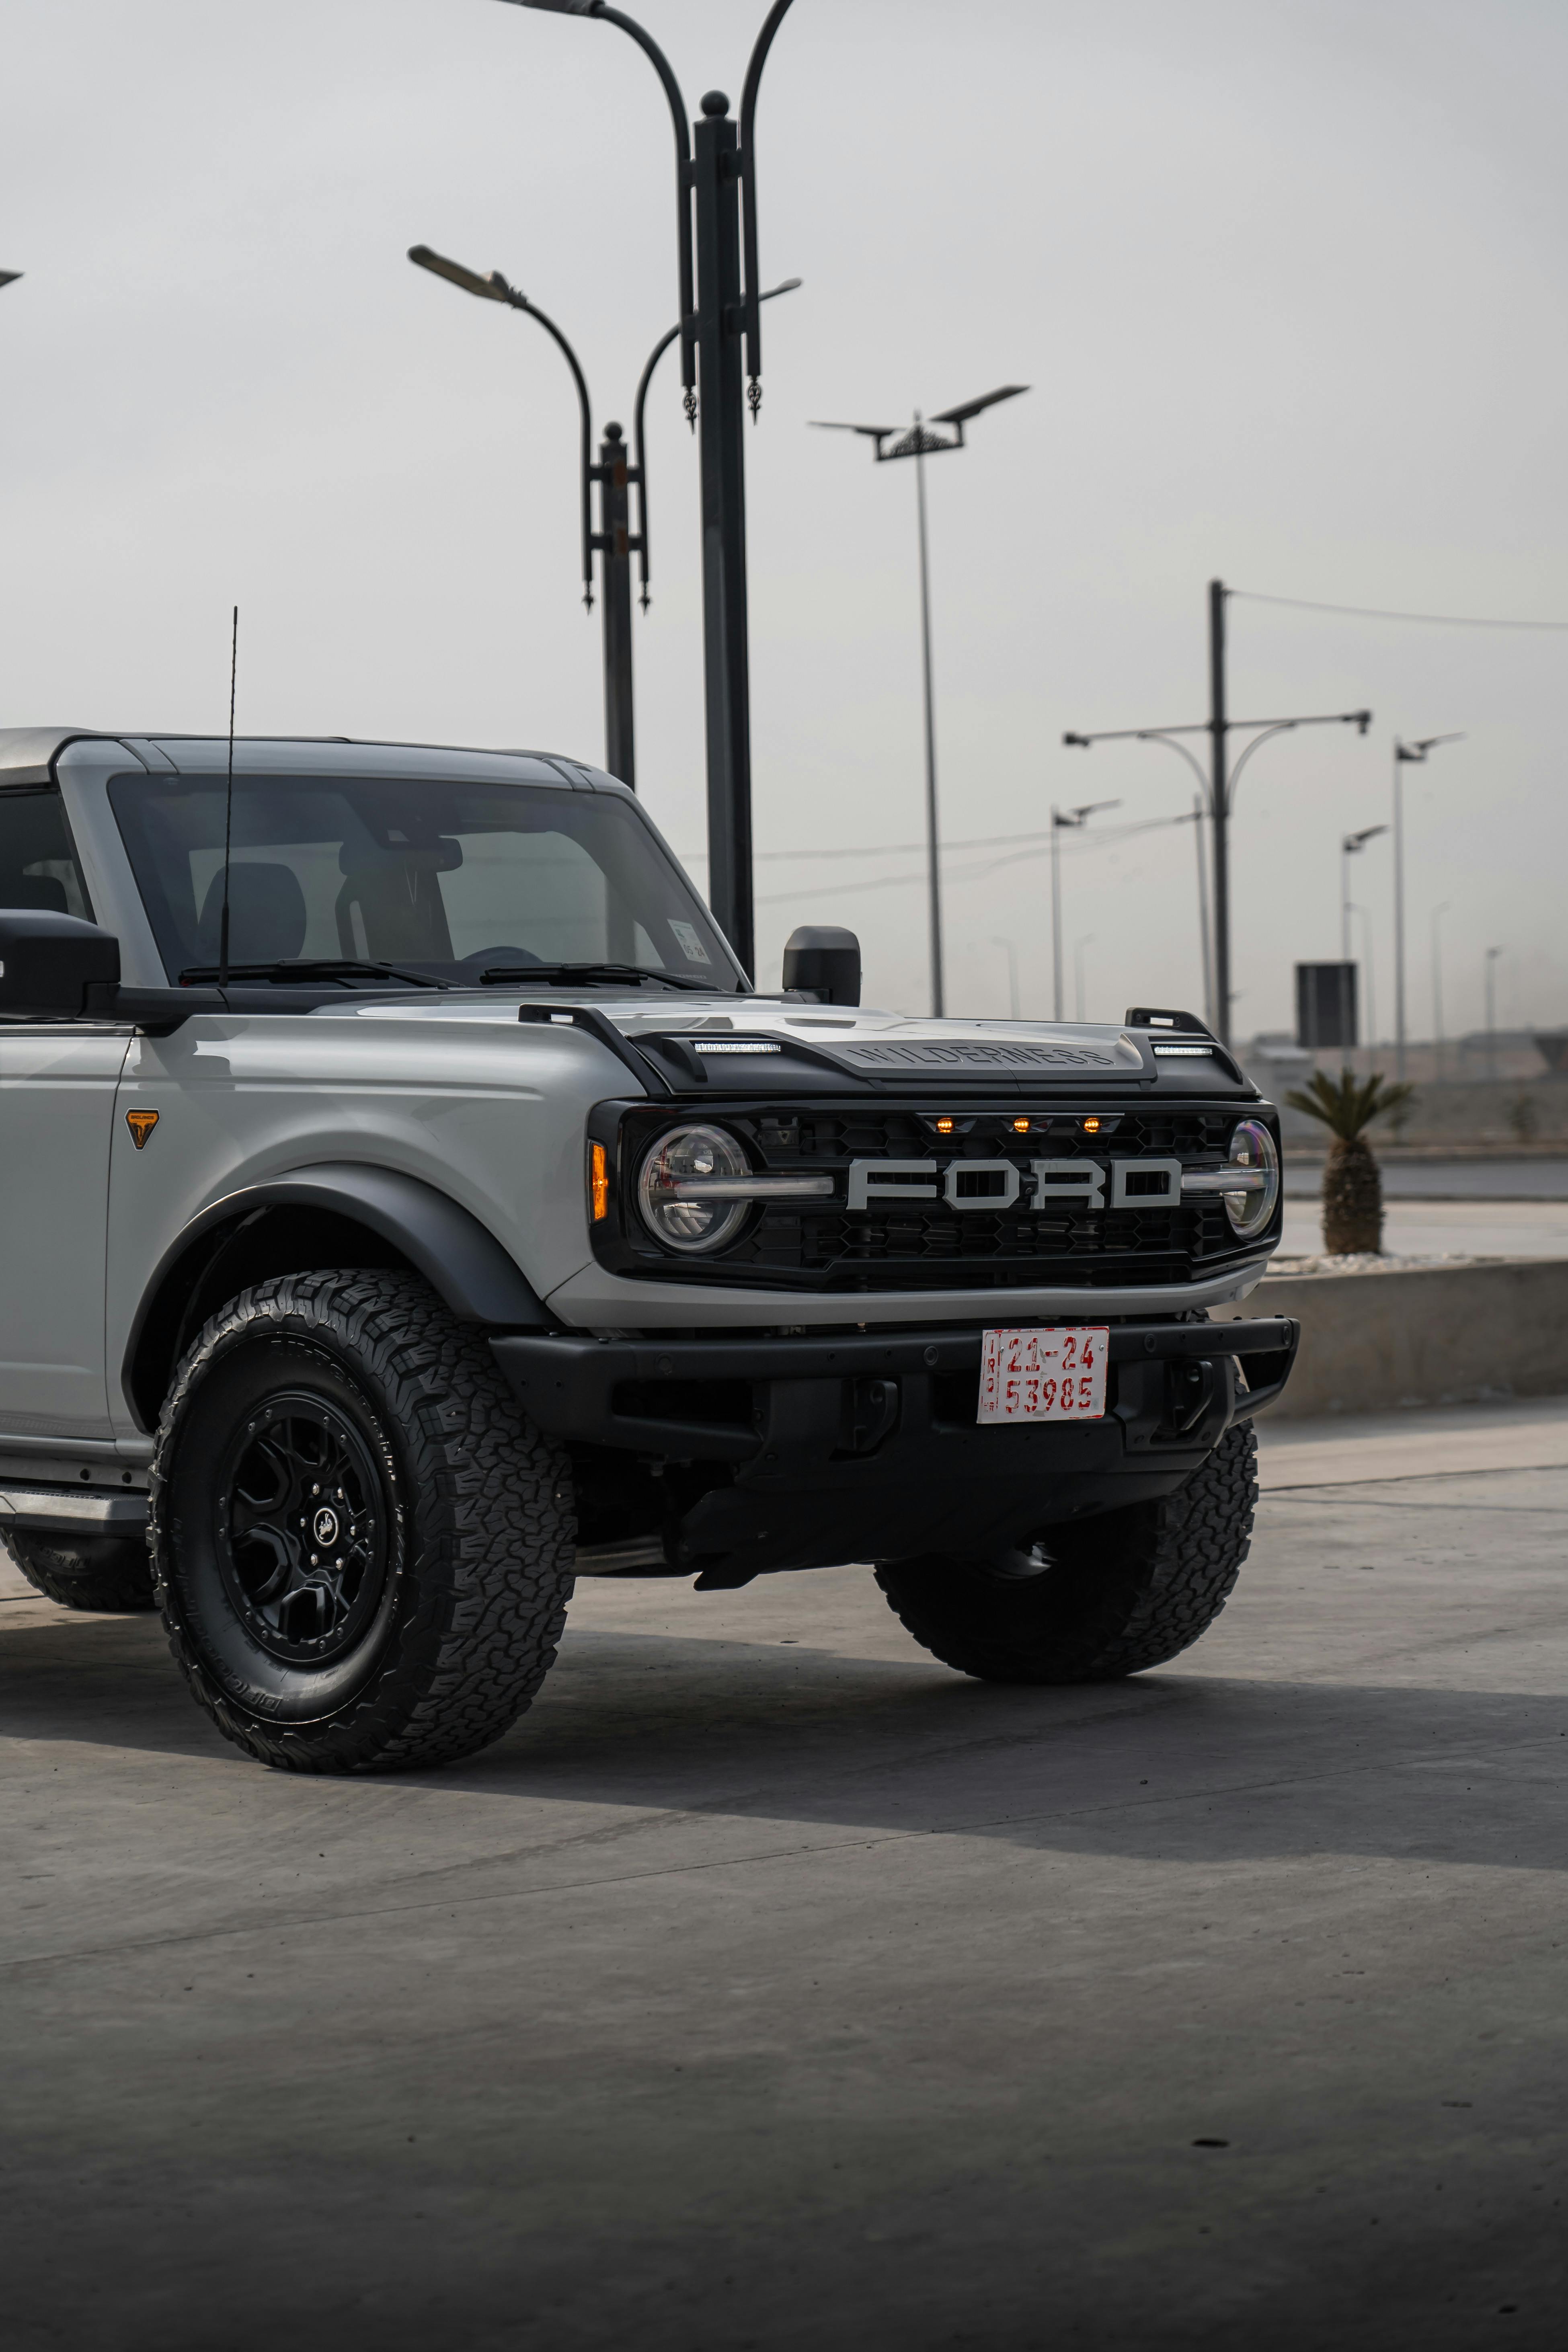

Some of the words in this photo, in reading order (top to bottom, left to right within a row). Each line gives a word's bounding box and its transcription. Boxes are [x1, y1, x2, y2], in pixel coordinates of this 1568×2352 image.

[846, 1046, 1115, 1065] WILDERNESS
[846, 1158, 1182, 1210] FORD
[1007, 1335, 1094, 1372] 21-24
[1006, 1377, 1093, 1414] 53985
